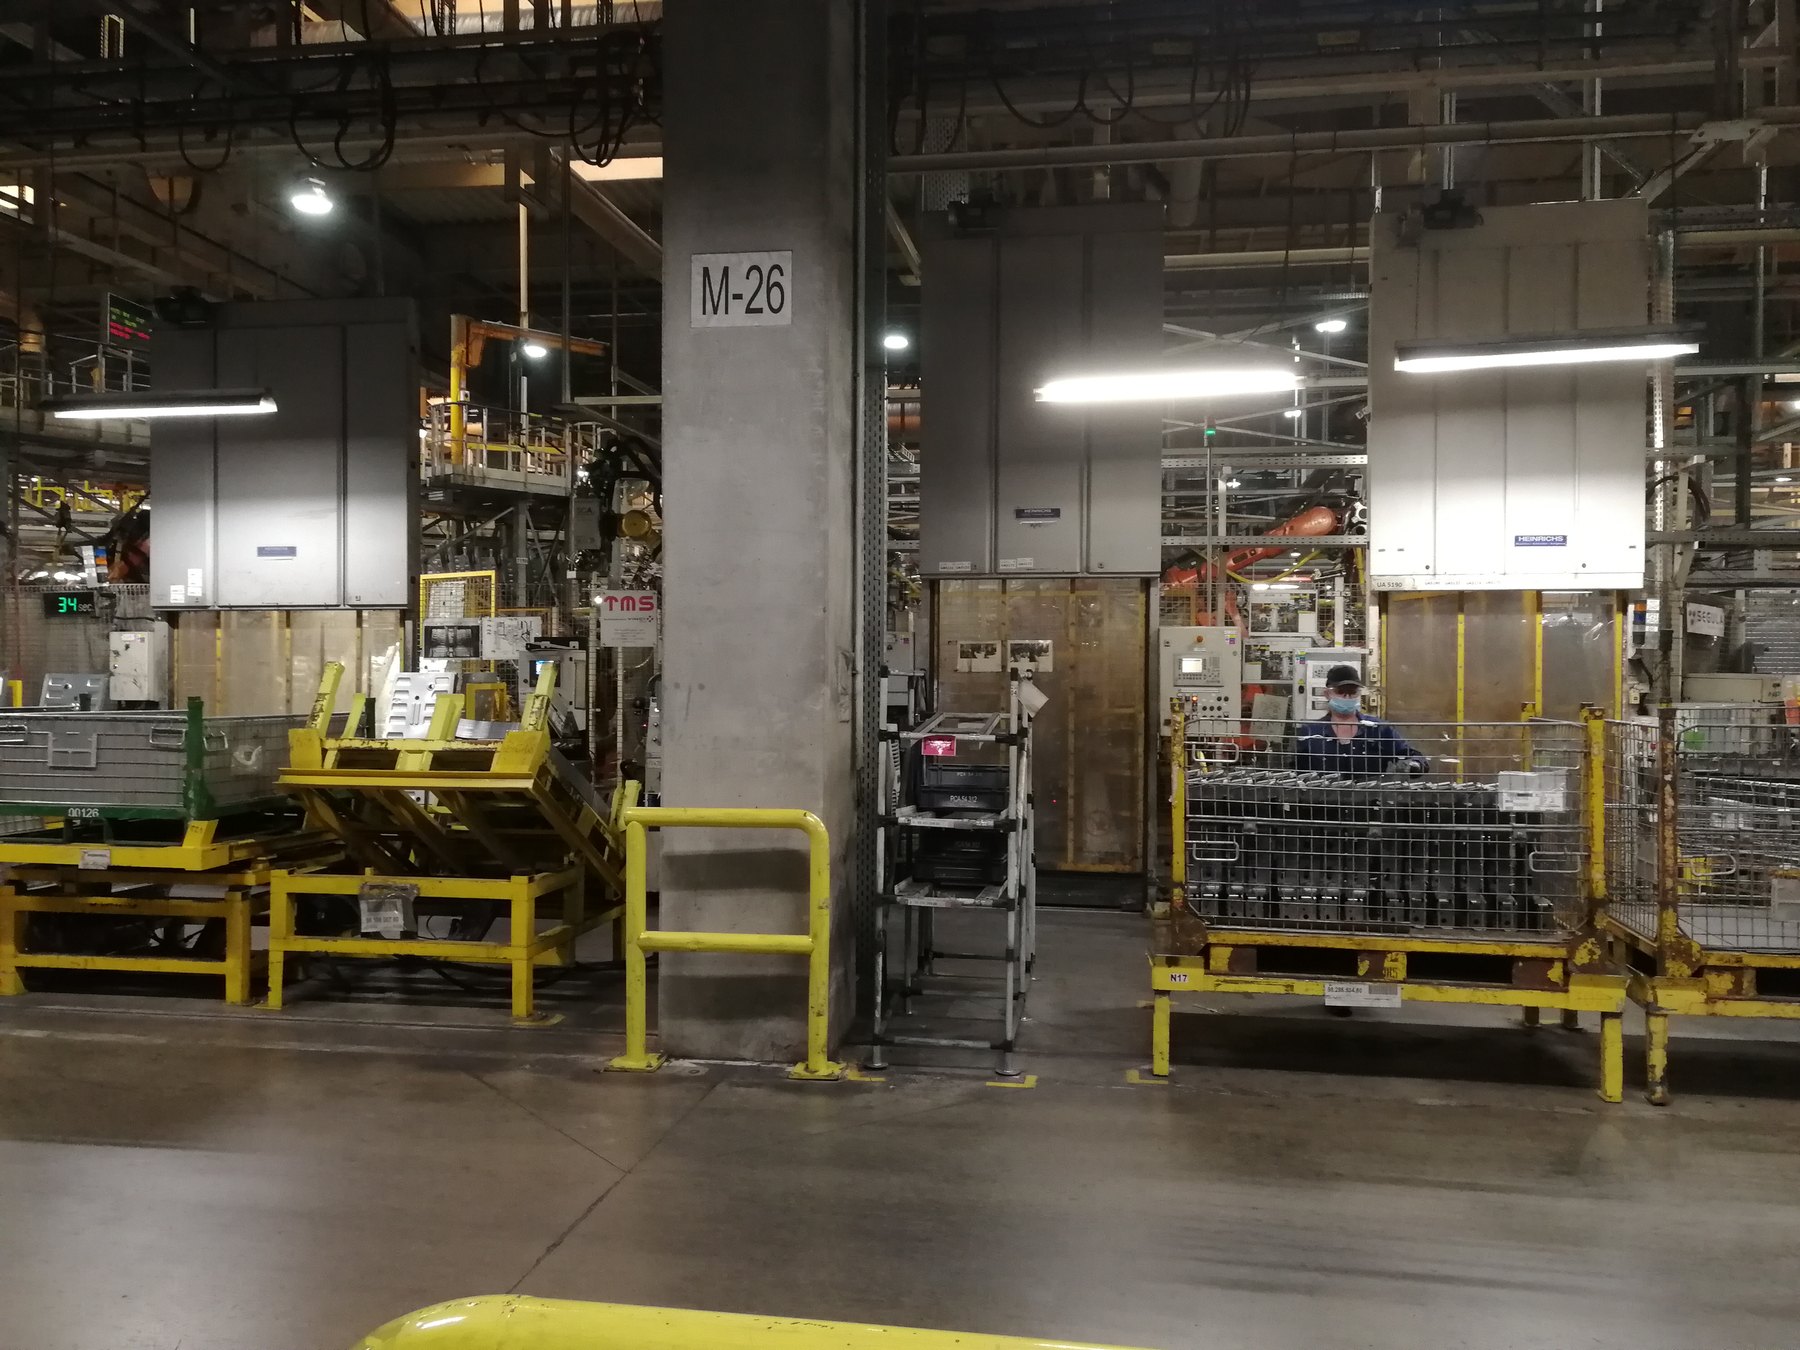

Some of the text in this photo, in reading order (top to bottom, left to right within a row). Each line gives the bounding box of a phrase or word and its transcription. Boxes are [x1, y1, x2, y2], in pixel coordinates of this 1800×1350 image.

[702, 264, 785, 315] M-26
[58, 597, 77, 613] 34
[604, 595, 655, 611] TMS
[68, 807, 99, 818] 00126
[1170, 973, 1188, 982] N17
